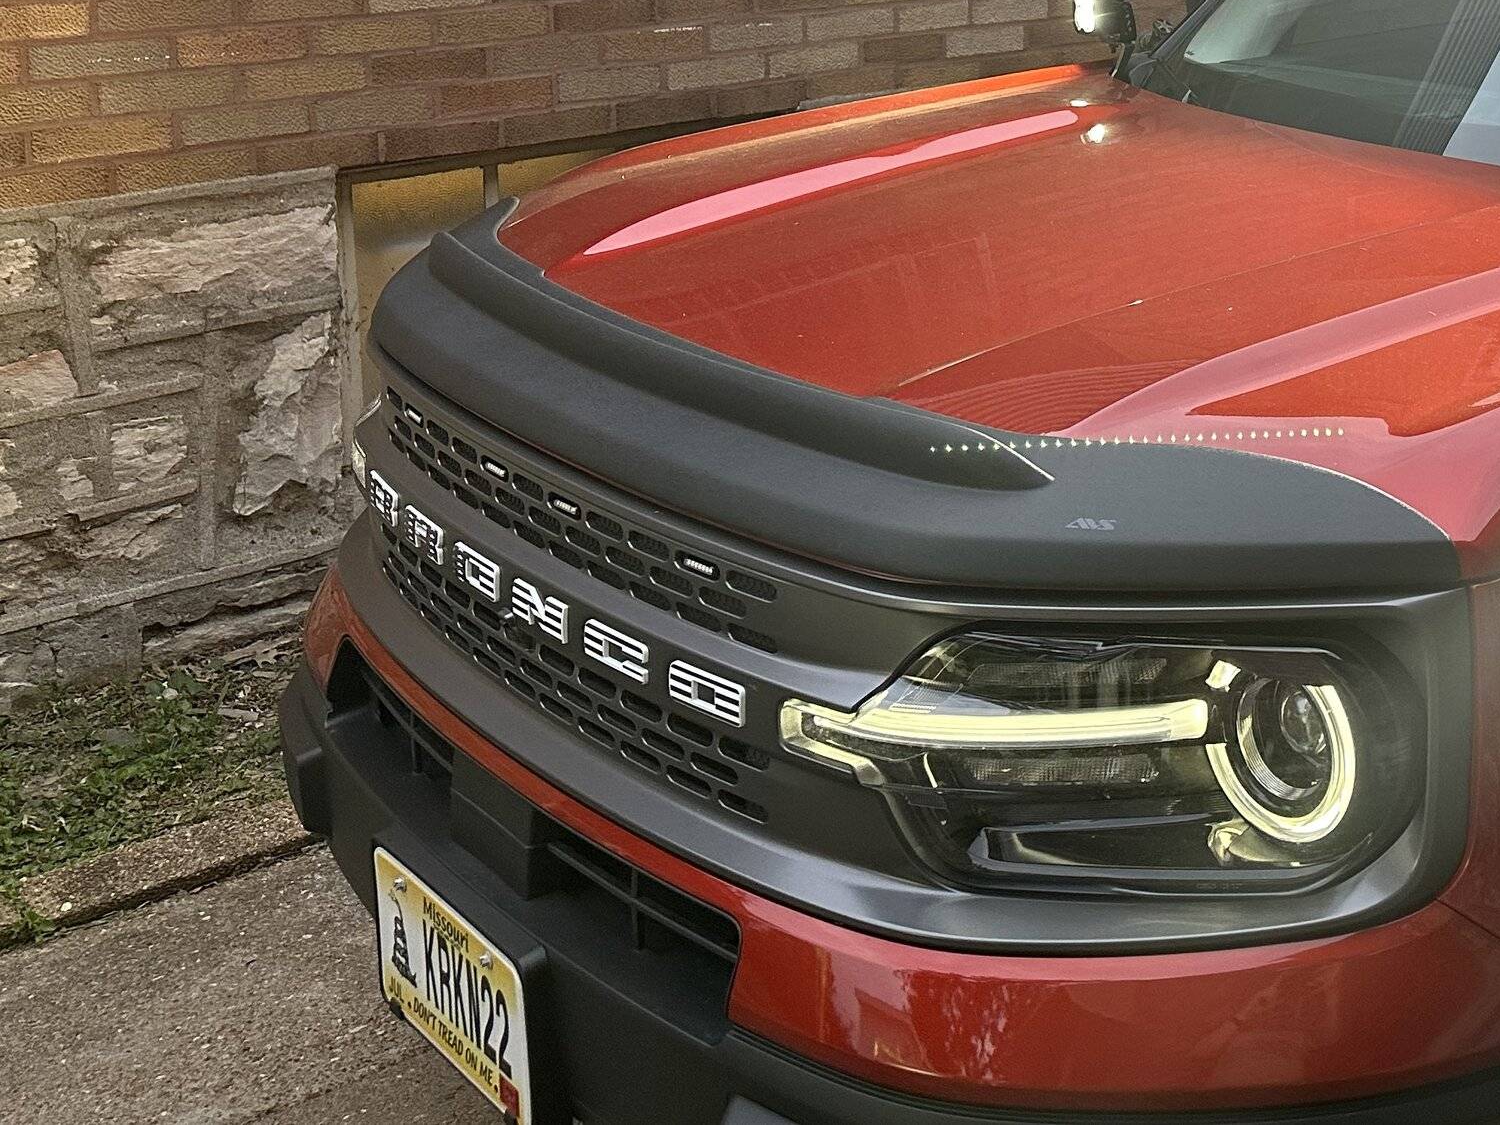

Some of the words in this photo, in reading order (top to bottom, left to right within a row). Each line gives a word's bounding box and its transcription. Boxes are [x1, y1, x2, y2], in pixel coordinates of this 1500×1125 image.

[369, 470, 746, 728] BRONCO
[422, 918, 513, 1080] KRKN22
[438, 1019, 464, 1055] TREAD
[465, 1047, 478, 1071] ON
[480, 1061, 494, 1087] ME
